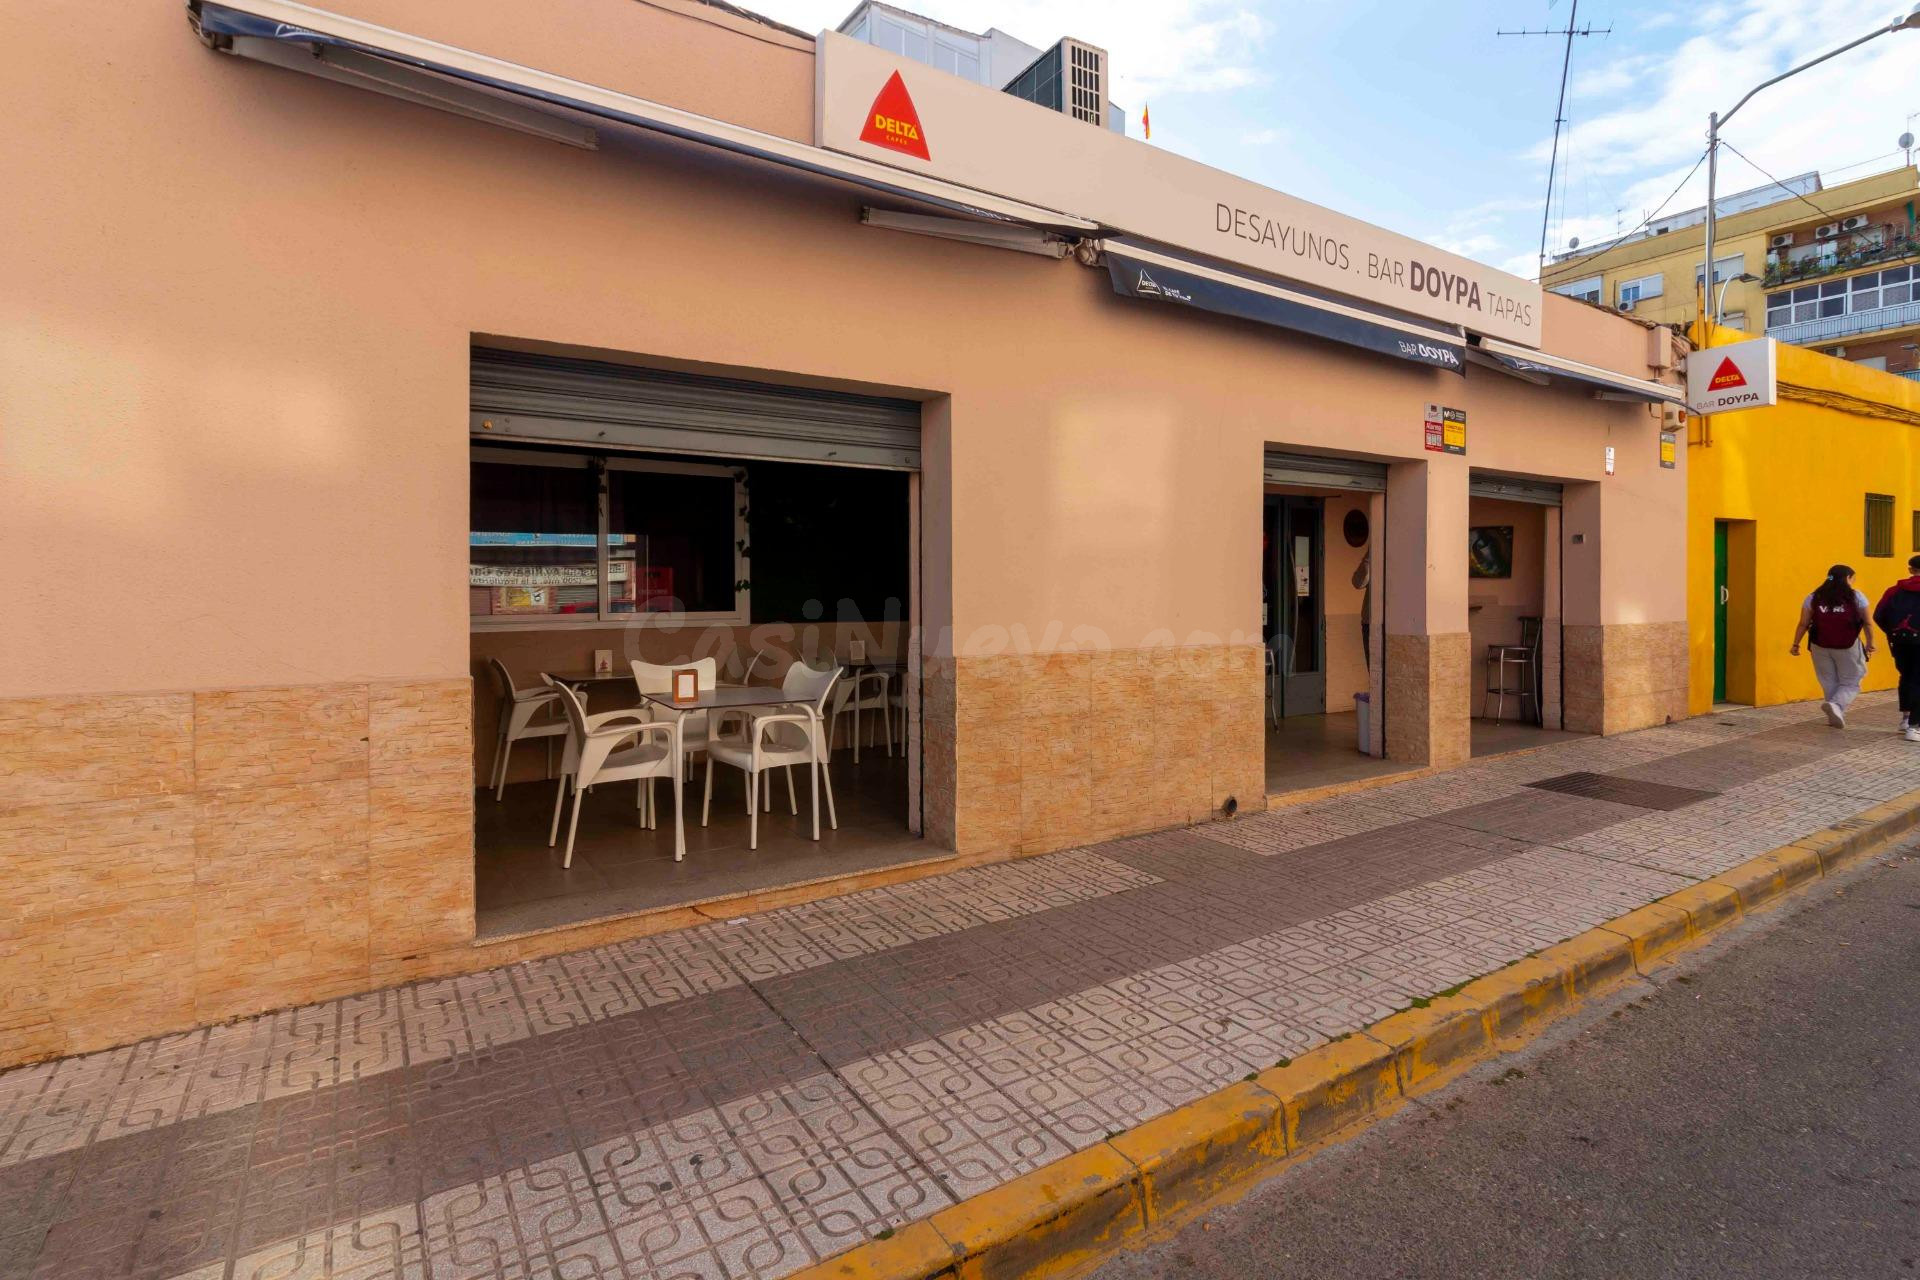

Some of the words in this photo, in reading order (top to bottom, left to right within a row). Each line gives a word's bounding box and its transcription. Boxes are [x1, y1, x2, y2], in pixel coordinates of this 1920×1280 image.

[875, 113, 919, 140] DELTA
[1216, 203, 1349, 270] DESAYUNOS
[1368, 252, 1404, 287] BAR
[1410, 260, 1482, 312] DOYPA
[1486, 291, 1532, 327] TAPAS
[1398, 341, 1417, 355] BAR
[1417, 343, 1460, 365] DOYPA
[1714, 374, 1741, 384] DELTA
[1696, 400, 1715, 410] BAR
[1717, 392, 1760, 407] DOYPA
